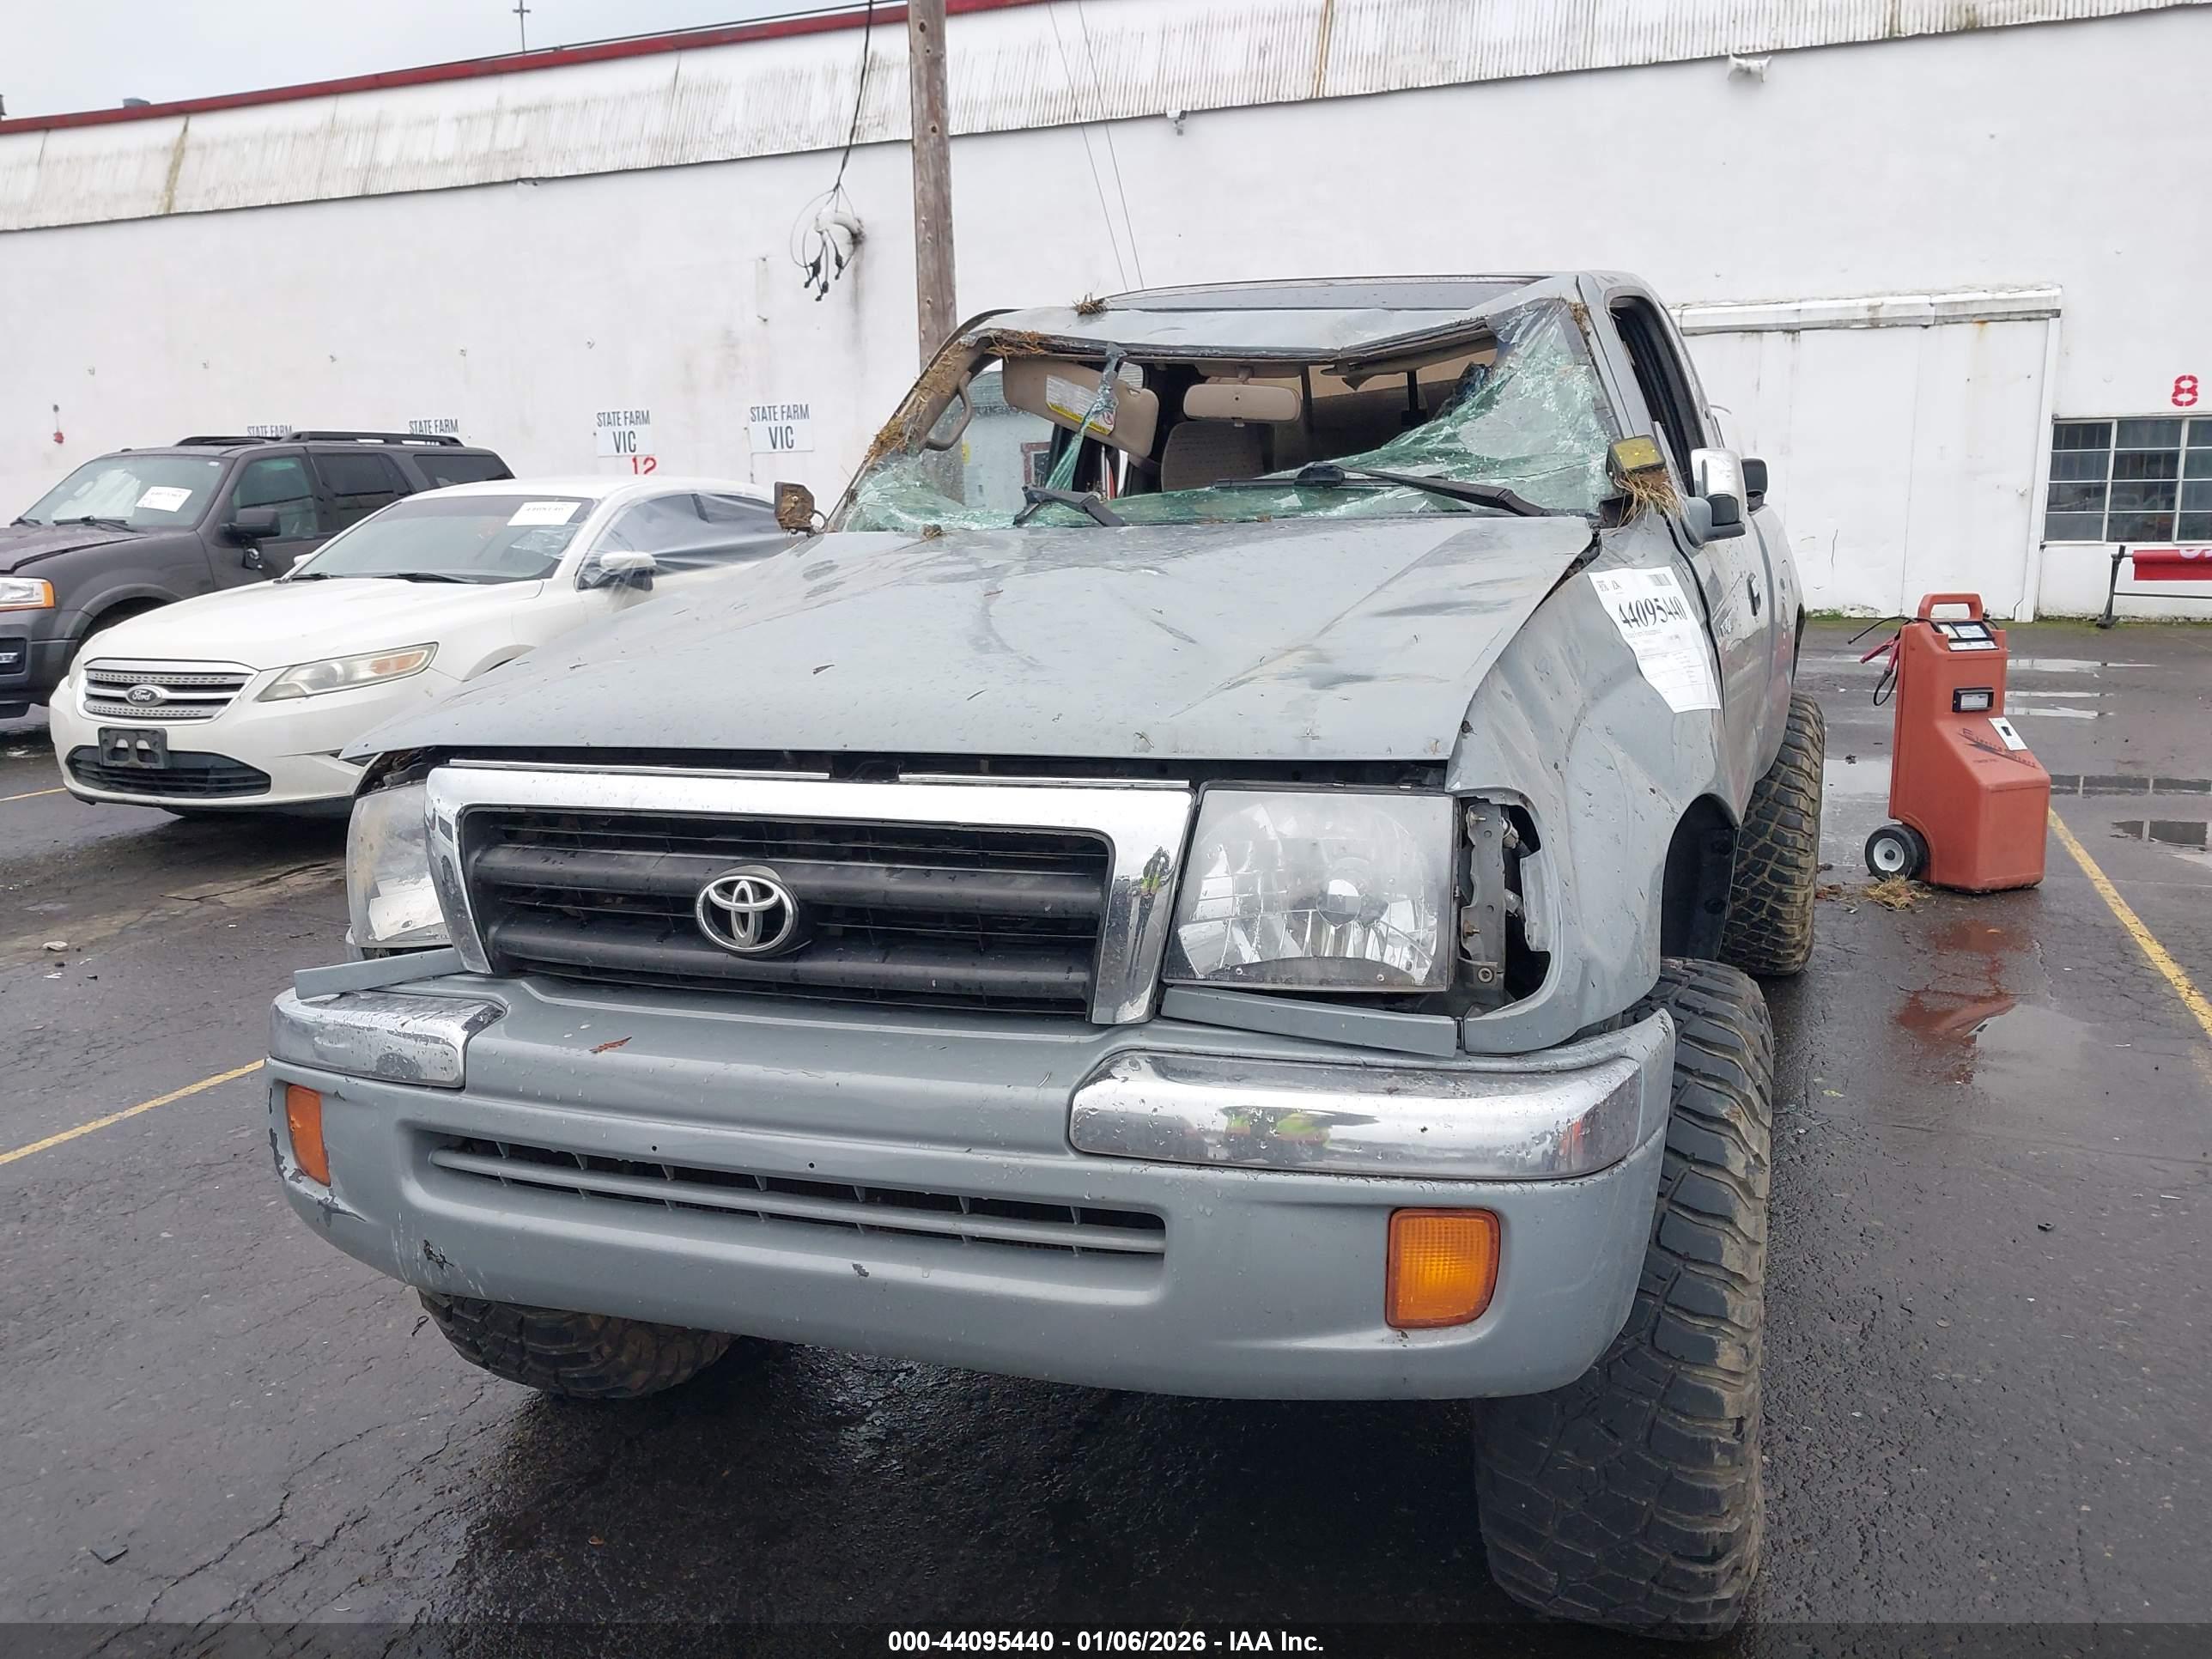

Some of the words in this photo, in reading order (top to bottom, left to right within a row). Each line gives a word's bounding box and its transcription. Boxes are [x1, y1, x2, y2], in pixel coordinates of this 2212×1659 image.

[2172, 374, 2199, 407] 8
[596, 411, 622, 428] STATE
[624, 410, 651, 426] FARM
[750, 405, 778, 422] STATE
[780, 404, 810, 421] FARM
[246, 425, 269, 437] STATE
[409, 420, 433, 434] STATE
[434, 418, 459, 434] FARM
[612, 430, 637, 453] VIC
[768, 425, 794, 450] VIC
[631, 456, 657, 475] 12
[1619, 596, 1688, 629] 44095440
[131, 689, 153, 701] Ford
